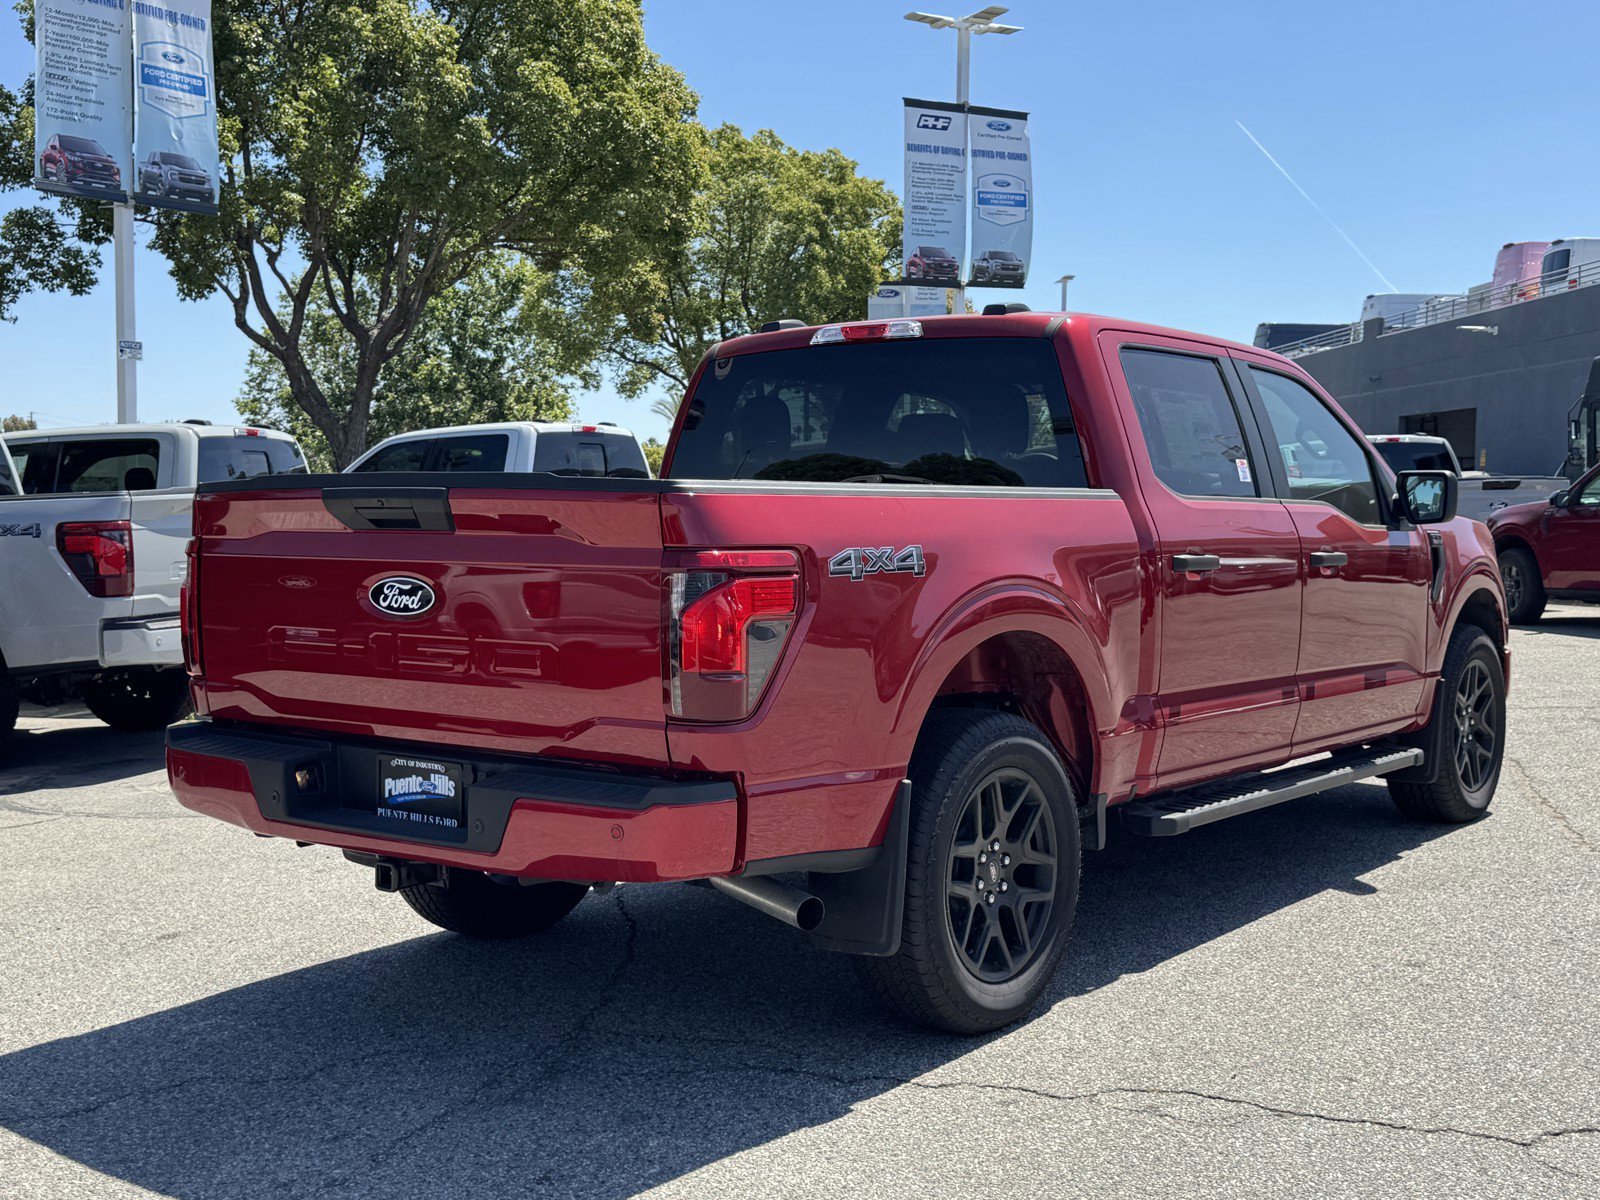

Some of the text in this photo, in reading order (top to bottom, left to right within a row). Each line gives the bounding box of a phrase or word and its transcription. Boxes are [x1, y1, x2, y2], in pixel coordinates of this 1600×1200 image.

[45, 13, 121, 34] Comprehensive Limited
[45, 19, 107, 37] Warranty Coverage
[165, 10, 206, 31] PRE-OWNED
[45, 41, 107, 58] Warranty Coverage
[84, 43, 107, 52] Limited
[46, 57, 78, 68] Financing
[80, 64, 108, 74] Available
[46, 62, 66, 71] Select
[75, 78, 98, 88] Vehicle
[144, 68, 203, 86] FORD CERTIFIED
[46, 80, 93, 93] History Report
[46, 90, 73, 100] 24-Hour
[46, 97, 82, 107] Assistance
[47, 106, 103, 121] 172-Point Quality
[394, 758, 407, 766] CITY
[416, 761, 441, 770] INDUSTRY
[385, 774, 455, 798] Puente Hills
[378, 808, 458, 828] PUENTE HILLS FORD
